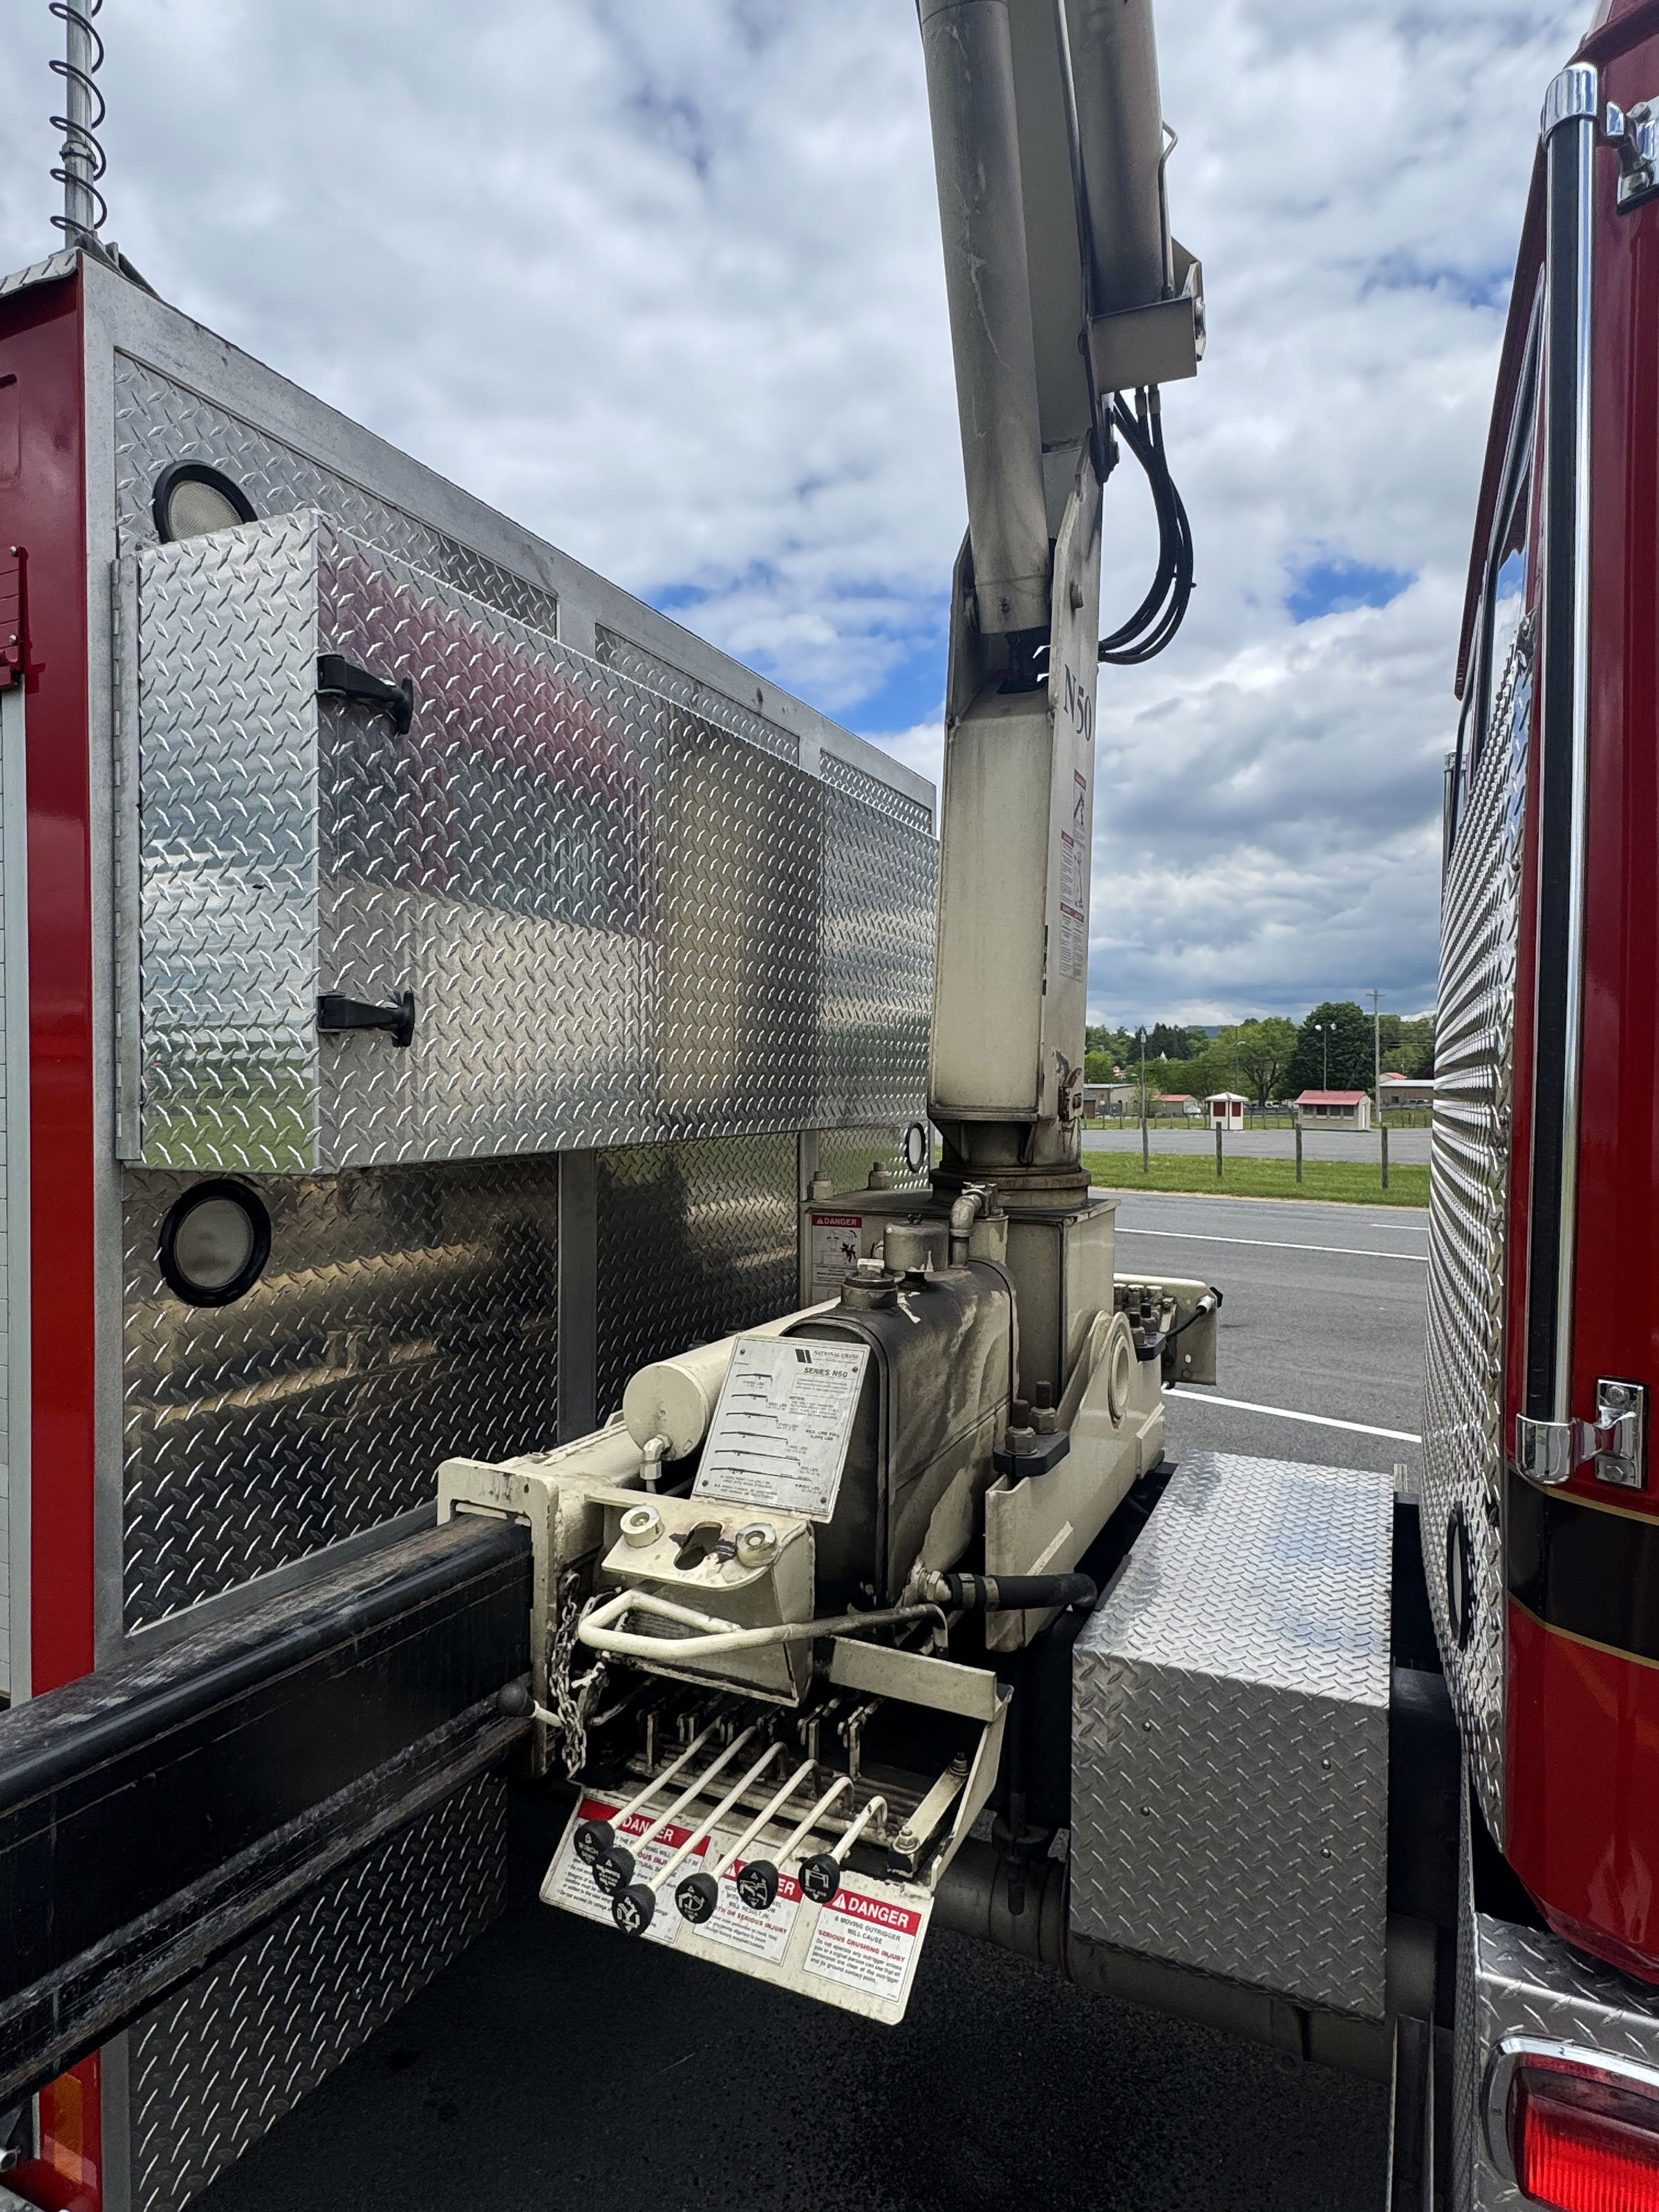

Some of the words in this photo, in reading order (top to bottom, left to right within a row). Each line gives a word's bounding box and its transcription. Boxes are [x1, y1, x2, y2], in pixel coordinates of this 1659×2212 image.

[1063, 664, 1092, 742] N50
[824, 1217, 857, 1226] DANGER
[803, 1367, 830, 1376] SERIES
[622, 1816, 674, 1841] DANER
[737, 1913, 763, 1926] SERIOUS
[765, 1922, 787, 1933] INJURY
[848, 1897, 909, 1928] DANGER
[840, 1918, 863, 1929] MOVING
[865, 1926, 900, 1941] OUTRIGGER
[862, 1933, 883, 1944] CAUSE
[818, 1930, 845, 1942] SERIOUS
[846, 1939, 879, 1953] CRUSHING
[881, 1951, 905, 1962] INJURY
